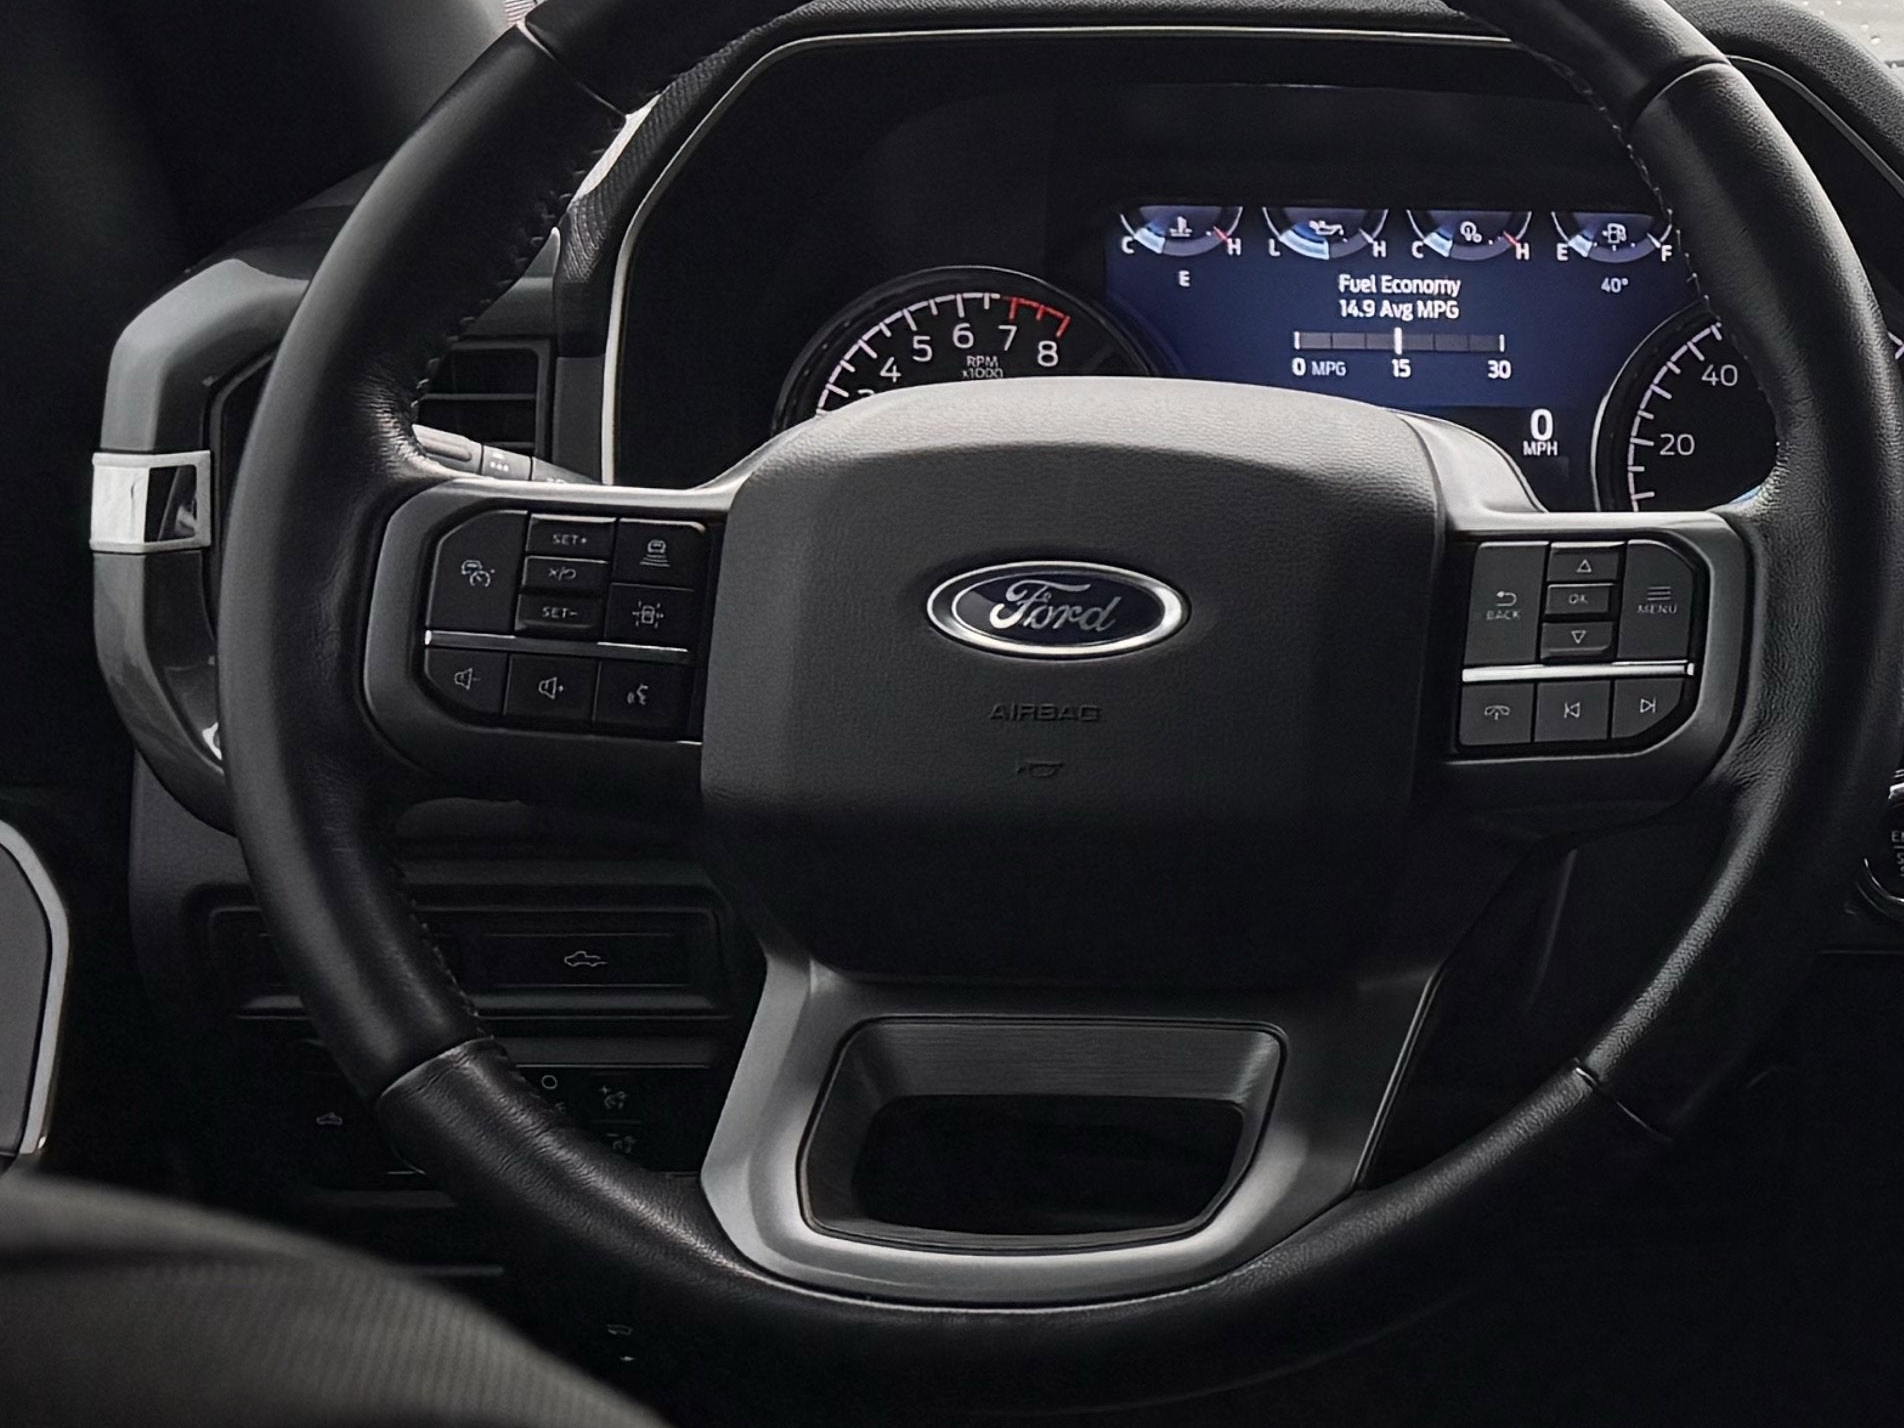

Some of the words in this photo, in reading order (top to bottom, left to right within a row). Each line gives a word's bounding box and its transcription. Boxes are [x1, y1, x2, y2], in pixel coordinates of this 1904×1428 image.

[1120, 235, 1136, 256] C
[1267, 236, 1282, 258] L
[1411, 239, 1425, 260] C
[1555, 241, 1570, 262] E
[1659, 243, 1674, 263] F
[1178, 270, 1190, 287] E
[1338, 273, 1377, 293] Fuel
[1380, 274, 1461, 298] Economy
[1600, 277, 1629, 293] 40°
[1339, 299, 1376, 318] 14.9
[1379, 299, 1414, 322] Avg
[1416, 300, 1459, 319] MPG
[952, 322, 974, 349] 6
[998, 324, 1018, 351] 7
[912, 335, 933, 362] 5
[1037, 340, 1058, 367] 8
[879, 356, 902, 383] 4
[966, 355, 998, 367] RPM
[1291, 357, 1306, 376] 0
[1311, 360, 1347, 376] MPG
[1391, 358, 1412, 378] 15
[1487, 359, 1512, 379] 30
[1701, 364, 1739, 387] 40
[1530, 408, 1553, 443] 0
[1523, 440, 1558, 456] MPH
[1659, 433, 1696, 456] 20
[988, 576, 1122, 635] Ford
[1486, 610, 1519, 620] BACK
[1637, 604, 1677, 614] MENU
[988, 702, 1101, 724] AIRBAG
